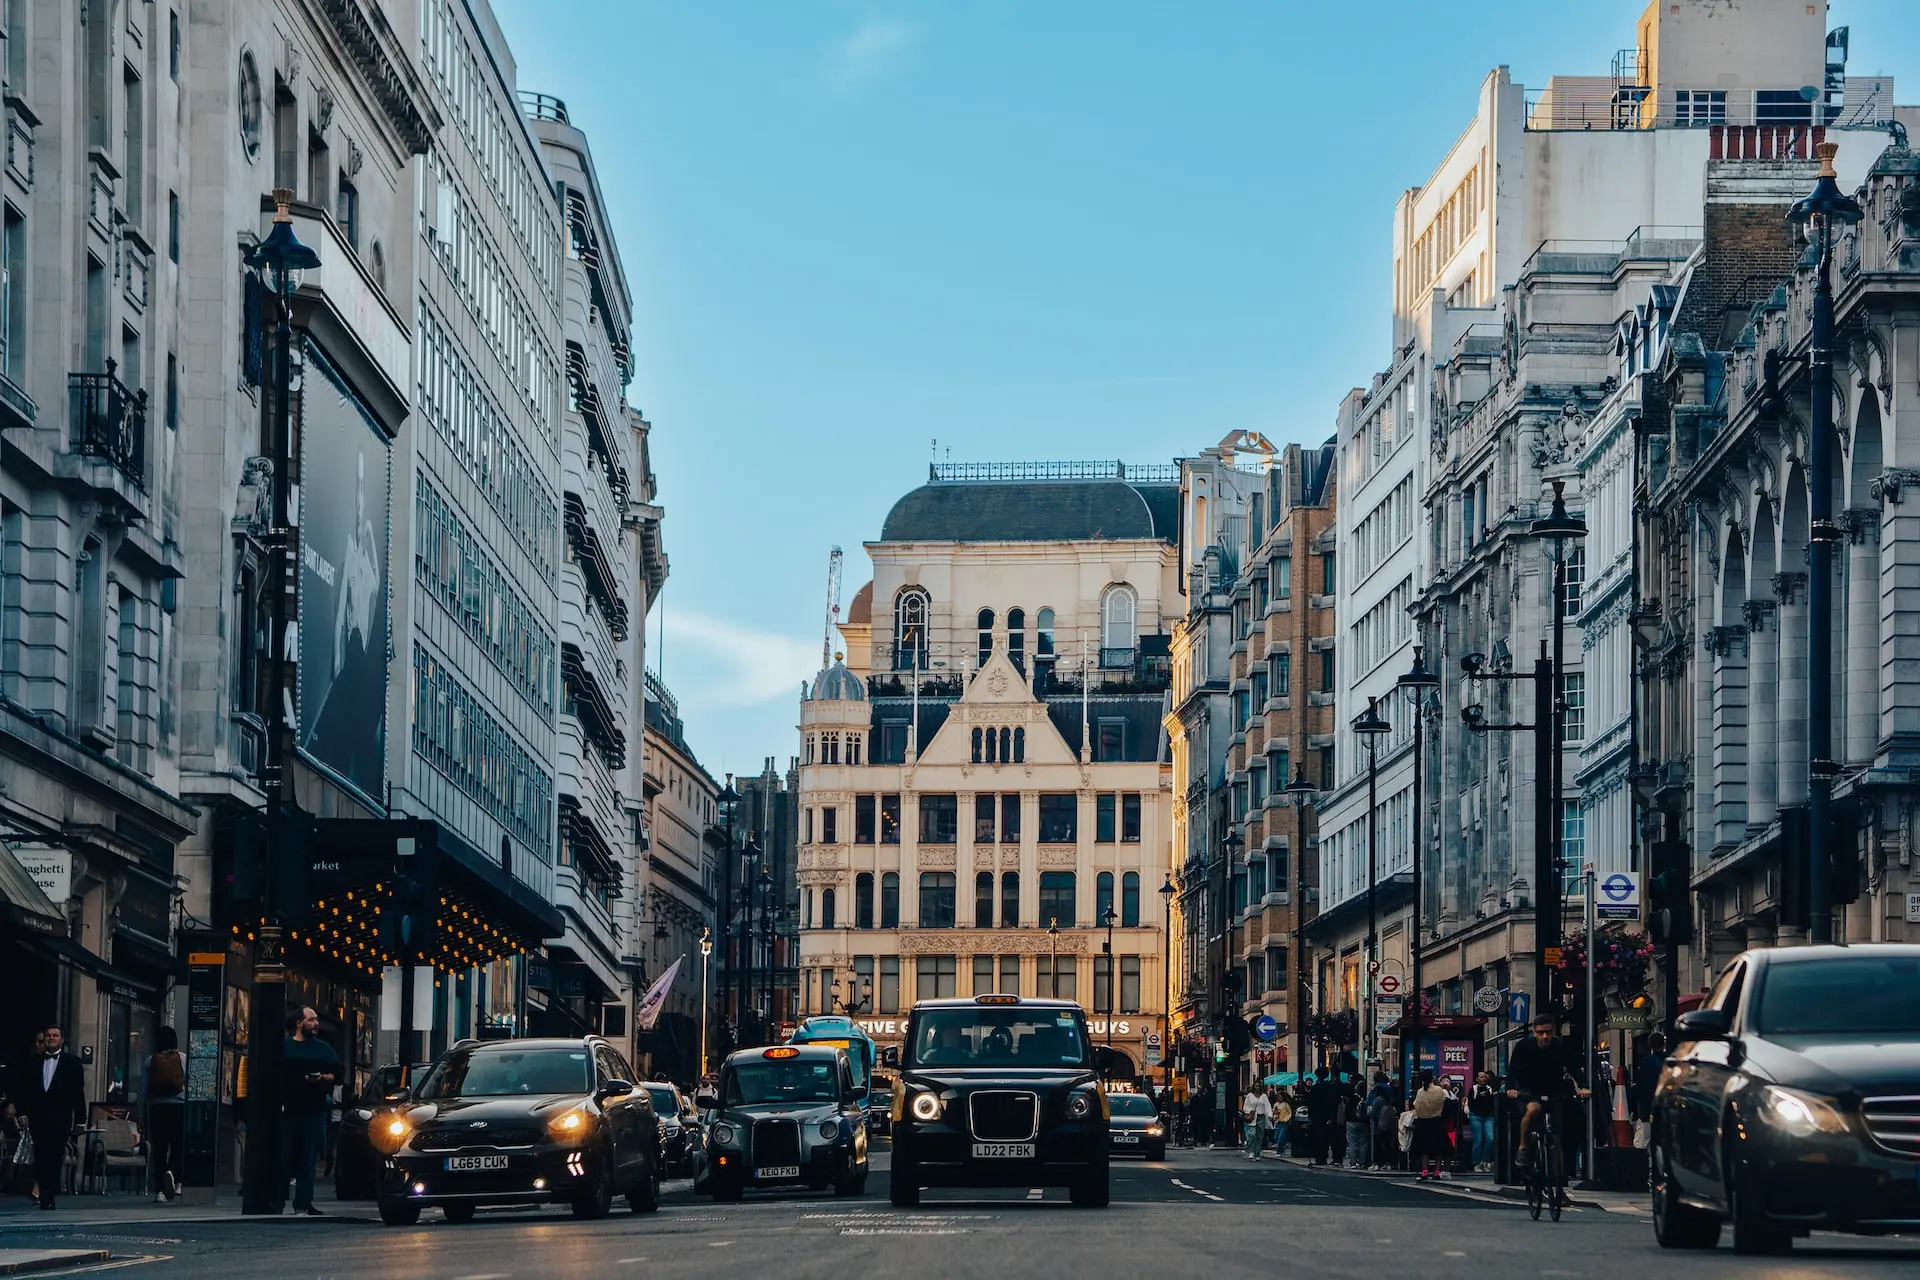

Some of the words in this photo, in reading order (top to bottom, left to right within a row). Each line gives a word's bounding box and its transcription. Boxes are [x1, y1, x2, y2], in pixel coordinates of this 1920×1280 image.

[304, 543, 317, 573] SAINT
[317, 554, 335, 587] LAURENT
[23, 864, 64, 876] aghetti
[858, 1021, 896, 1034] FIVE
[1086, 1021, 1130, 1034] GUYS
[1444, 1052, 1467, 1062] PEEL
[976, 1145, 1006, 1156] LD22
[1008, 1145, 1031, 1156] FBK
[451, 1157, 481, 1169] LG69
[484, 1156, 508, 1168] CUK
[760, 1167, 779, 1177] AE10
[780, 1166, 798, 1176] FKD
